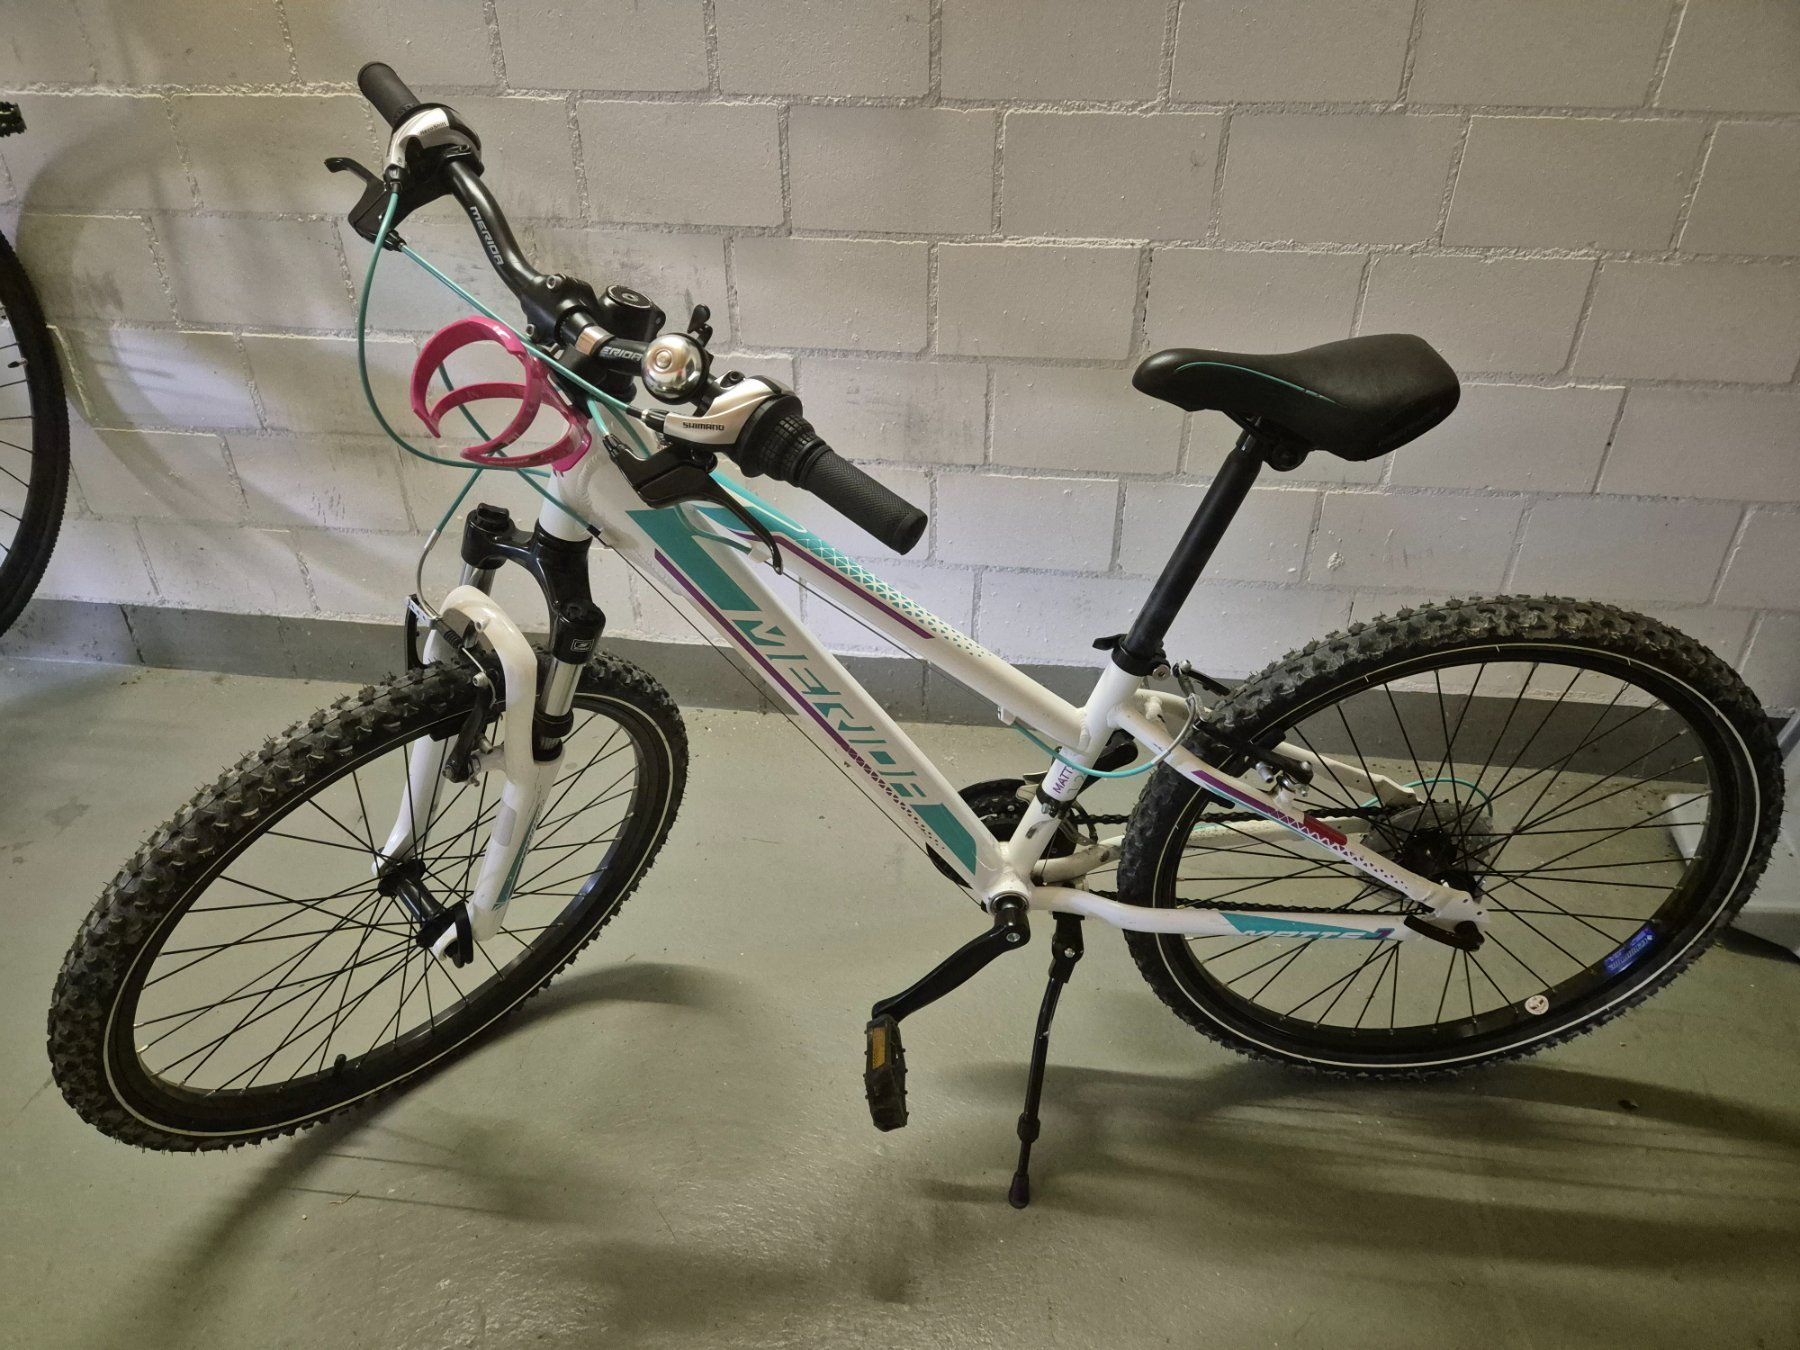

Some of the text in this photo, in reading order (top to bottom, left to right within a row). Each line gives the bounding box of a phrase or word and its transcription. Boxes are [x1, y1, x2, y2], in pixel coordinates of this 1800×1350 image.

[469, 206, 505, 266] MERIDA
[599, 345, 644, 361] ERIDA
[682, 421, 725, 431] SHIMANO
[731, 616, 935, 801] MERIDA
